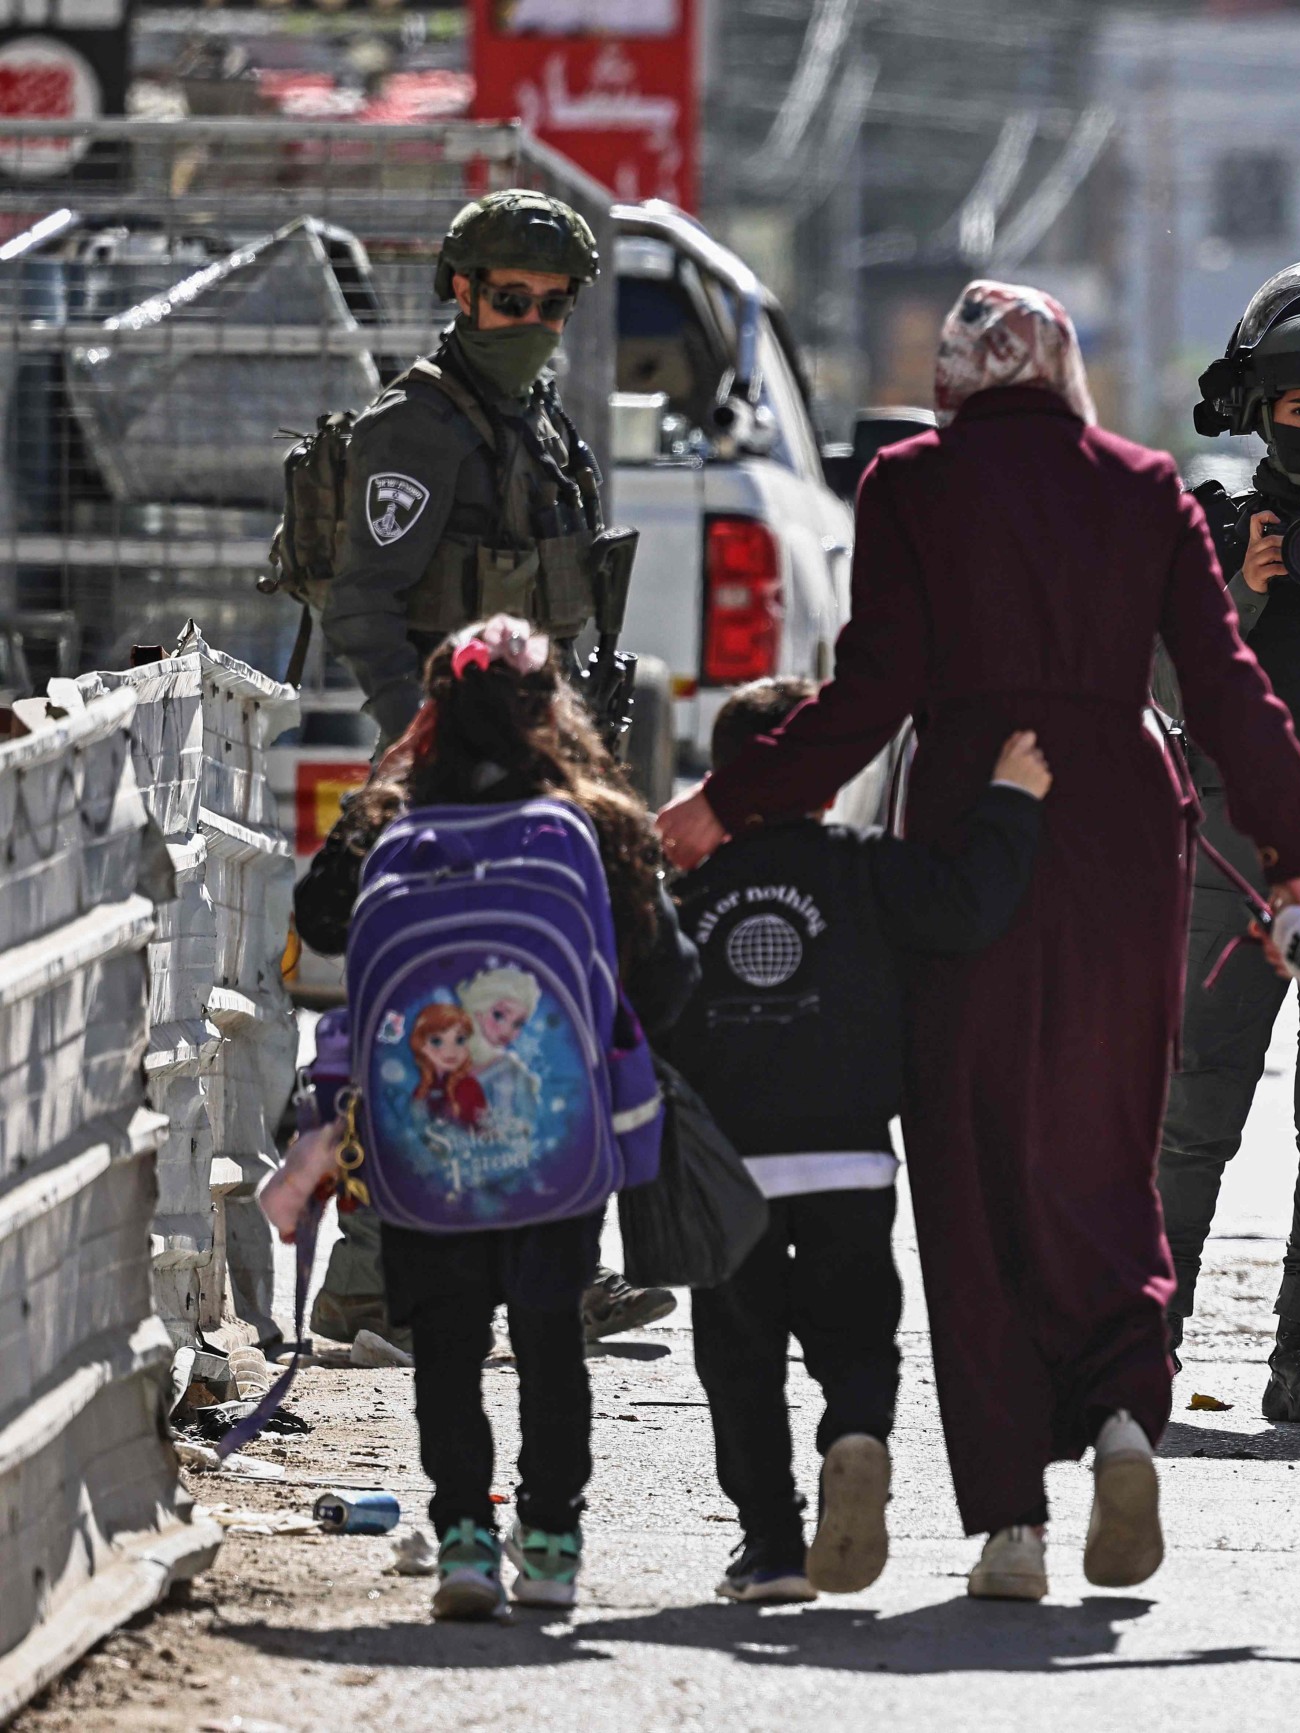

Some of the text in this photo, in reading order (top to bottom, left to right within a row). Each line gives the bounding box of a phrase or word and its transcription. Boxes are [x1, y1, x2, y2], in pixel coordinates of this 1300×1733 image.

[696, 884, 829, 945] all or nothing
